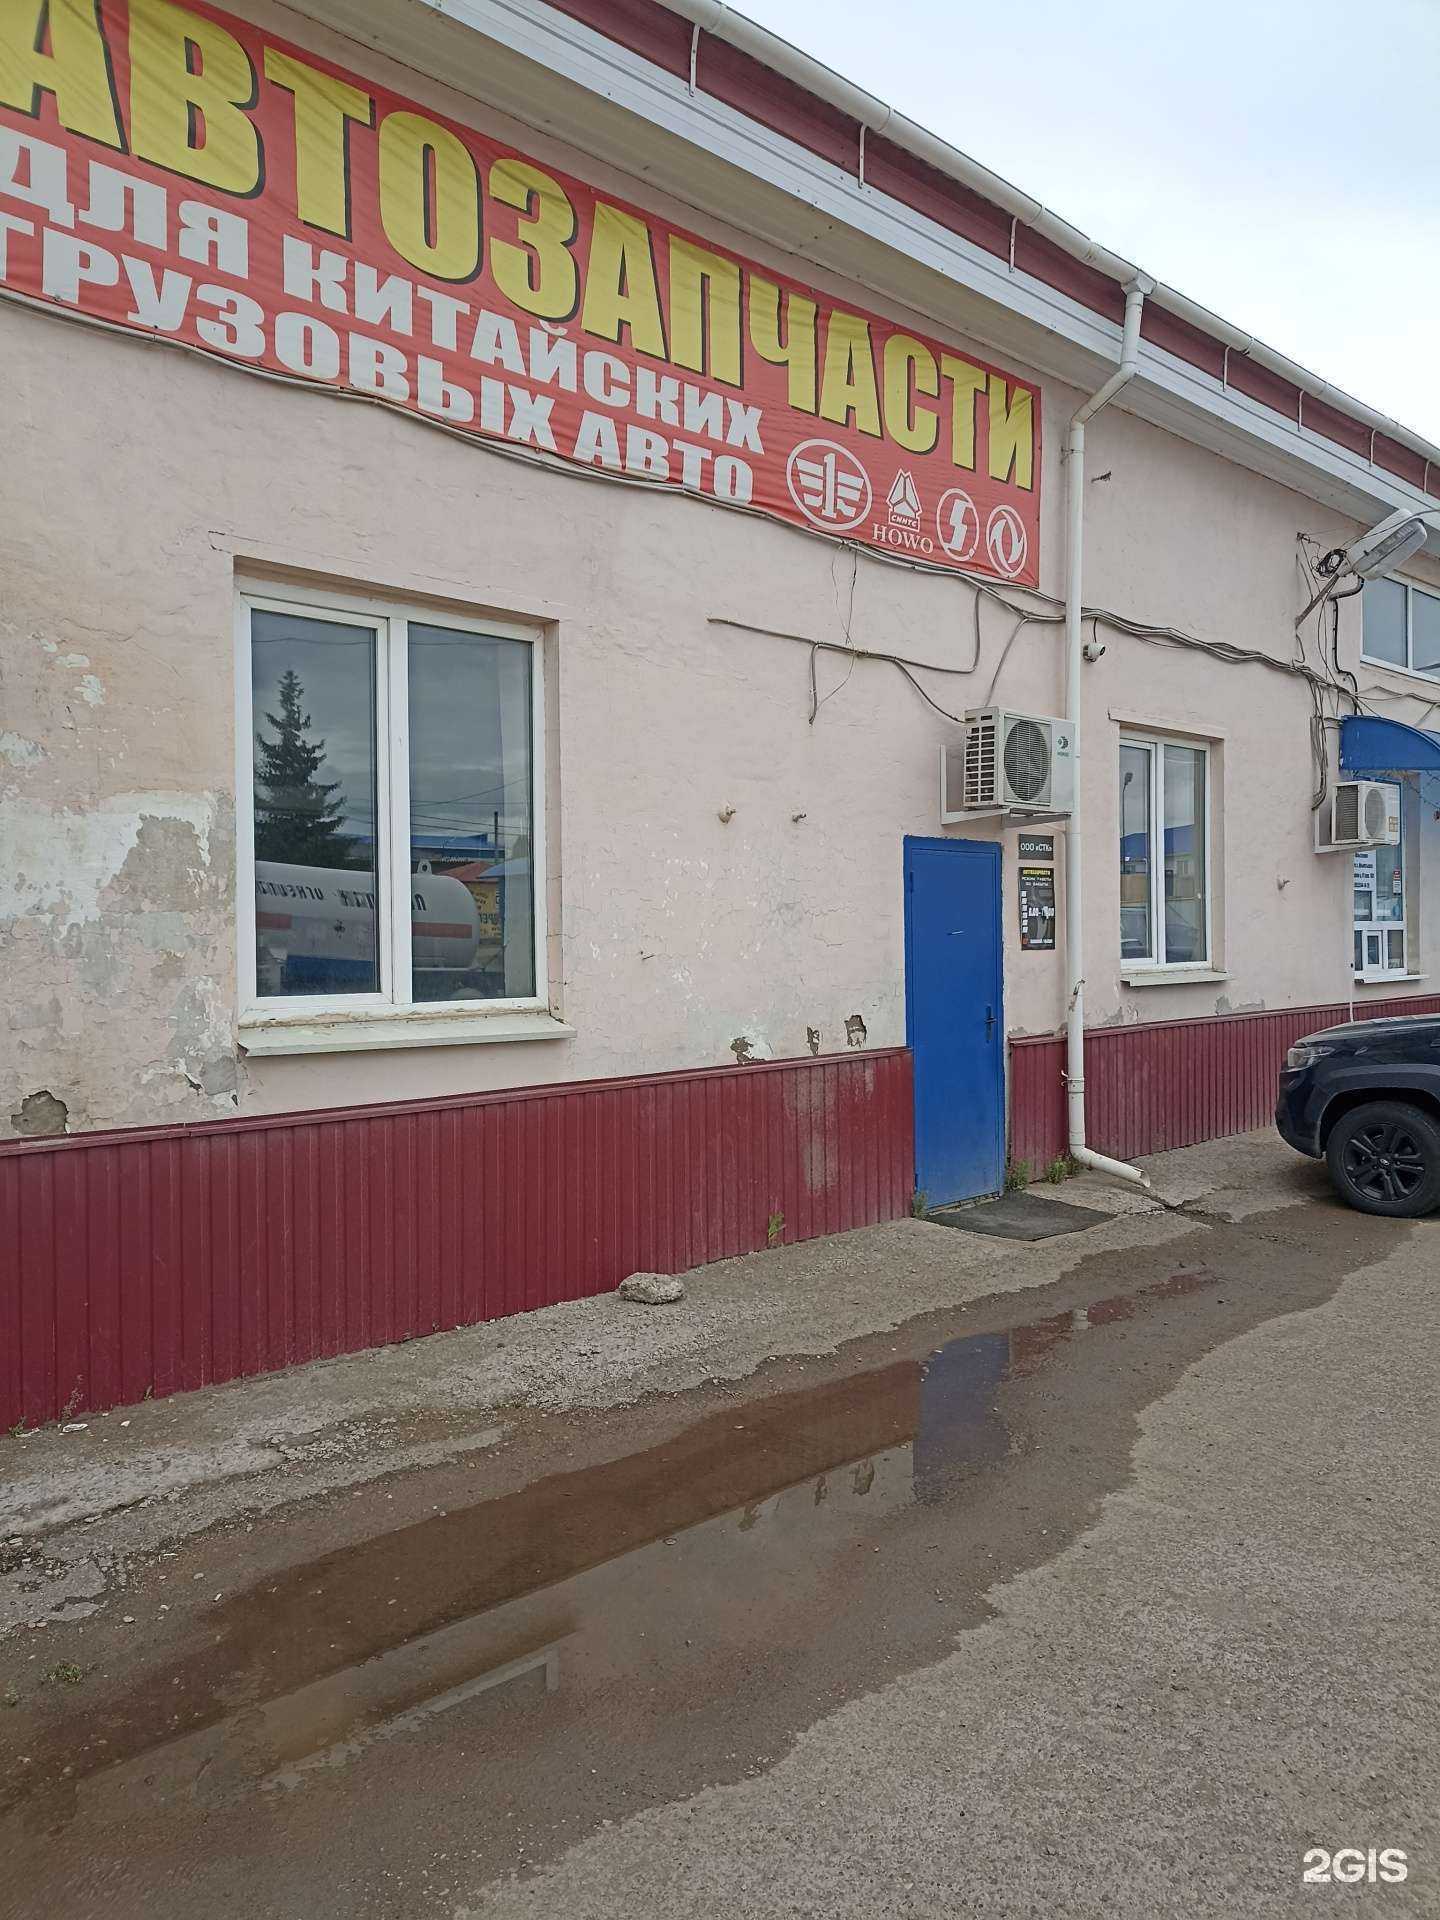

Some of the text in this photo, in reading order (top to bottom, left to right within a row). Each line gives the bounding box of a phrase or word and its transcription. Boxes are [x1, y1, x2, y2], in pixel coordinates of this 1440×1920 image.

[0, 0, 1034, 493] АВТОЗАПЧАСТИ
[0, 126, 766, 455] ДЛЯ КИТАЙСКИХ
[573, 409, 754, 505] АВТО
[872, 522, 934, 554] HOWO
